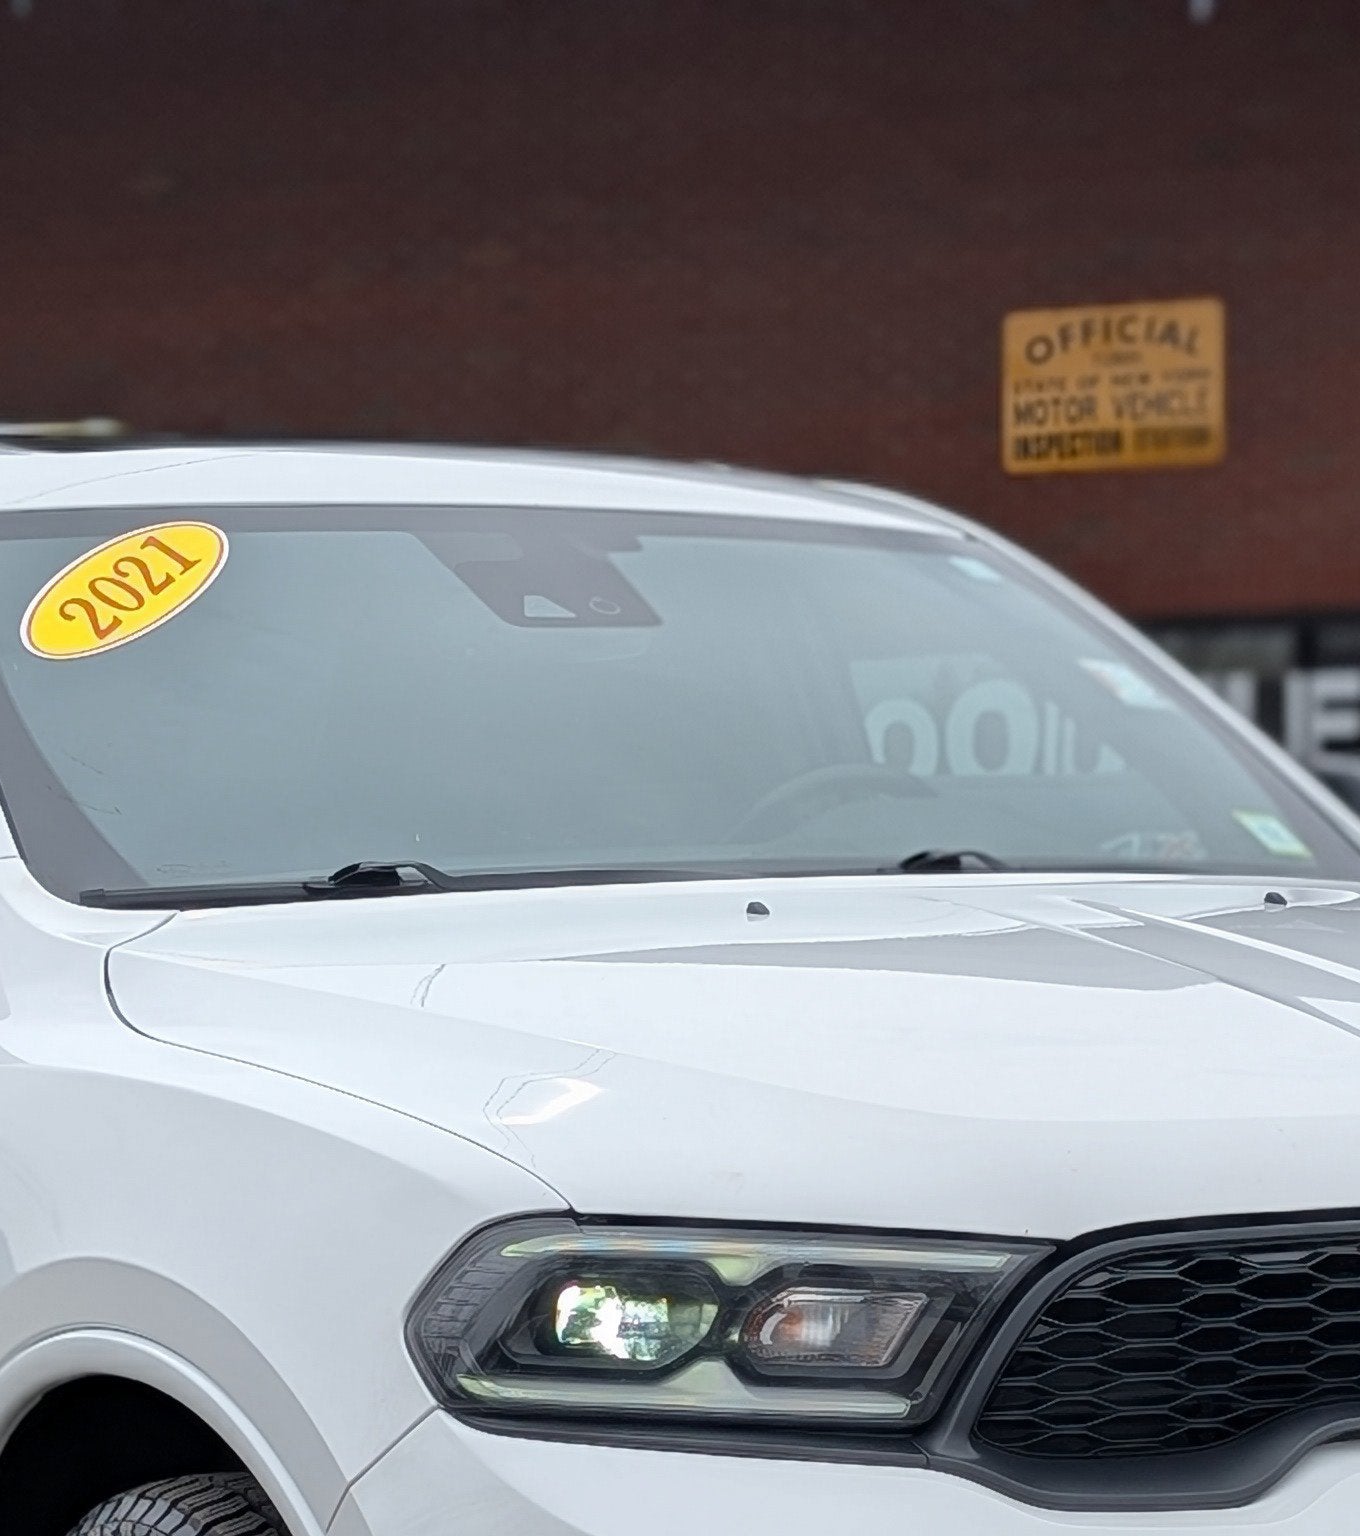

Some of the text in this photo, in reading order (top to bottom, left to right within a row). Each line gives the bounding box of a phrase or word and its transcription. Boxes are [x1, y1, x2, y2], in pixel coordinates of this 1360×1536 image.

[1024, 314, 1200, 366] OFFICIAL
[1013, 386, 1208, 427] MOTOR VEHICLE
[1013, 429, 1124, 462] INSPECTION
[59, 536, 202, 640] 2021
